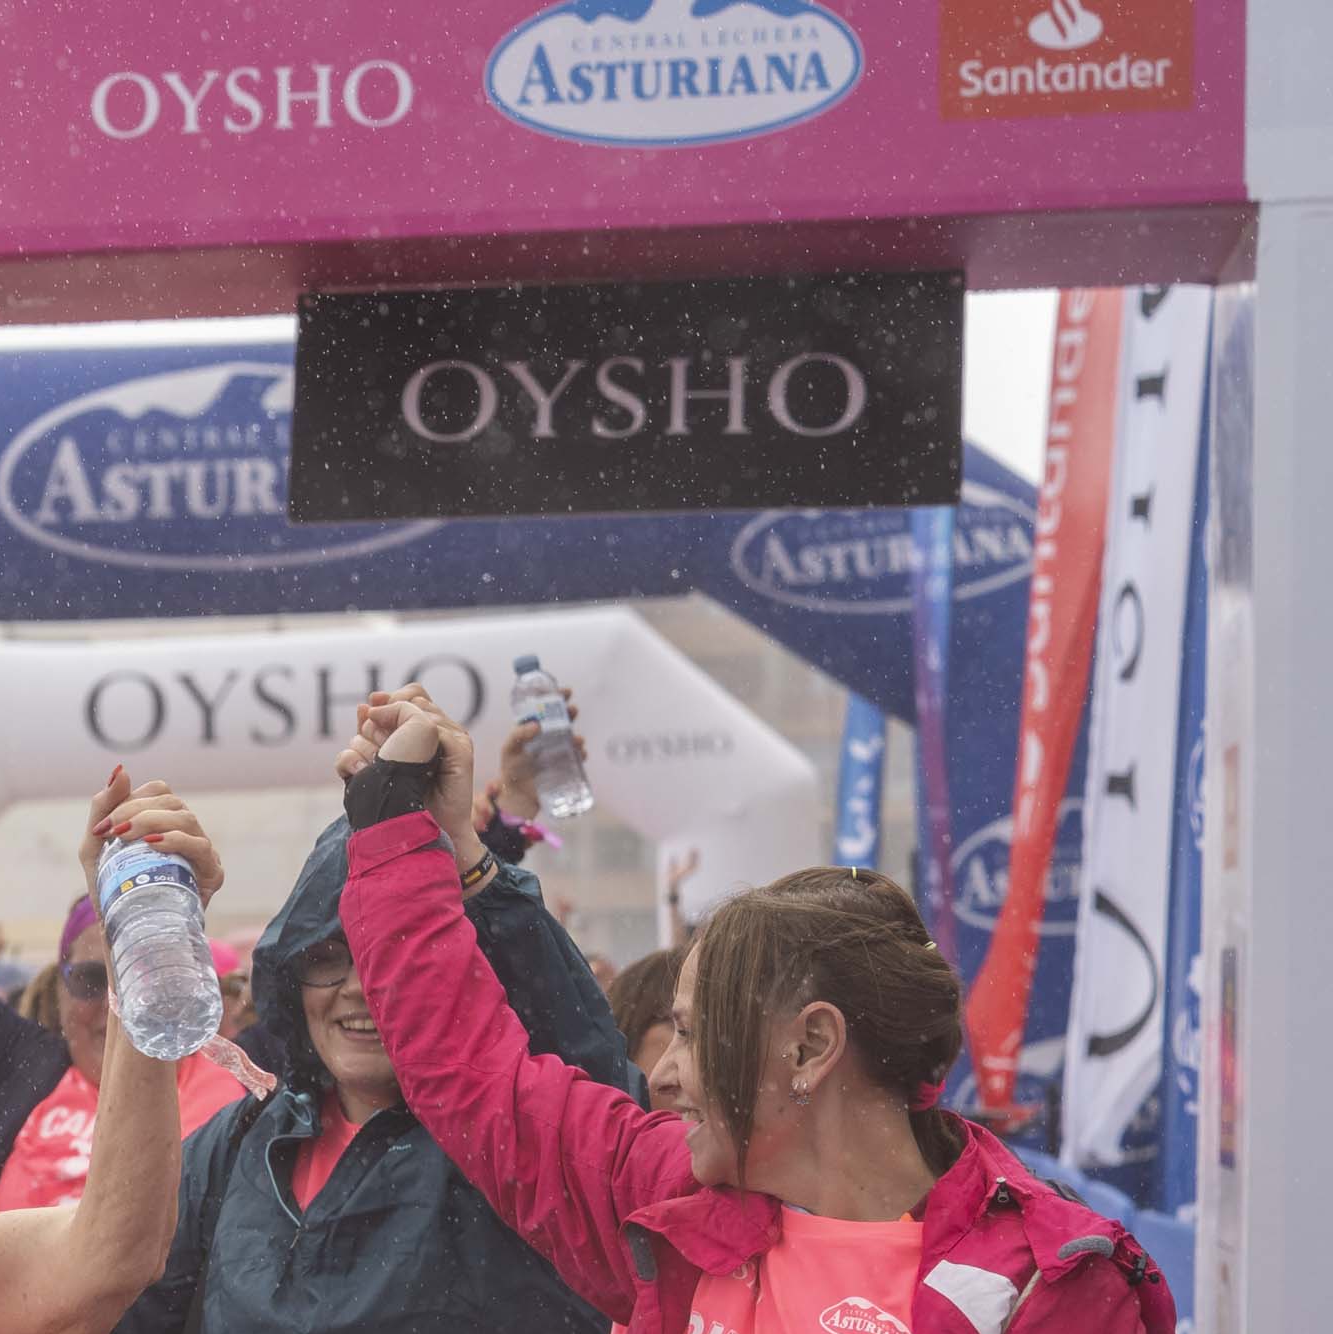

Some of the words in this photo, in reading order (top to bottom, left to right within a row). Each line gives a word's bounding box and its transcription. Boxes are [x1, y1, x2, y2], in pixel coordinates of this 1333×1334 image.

[516, 41, 833, 106] ASTURIANA
[571, 30, 687, 53] CENTRAL
[700, 26, 820, 48] LECHERA
[958, 53, 1172, 98] Santander
[90, 59, 414, 140] OYSHO
[401, 353, 867, 442] OYSHO
[36, 435, 290, 524] ASTUR
